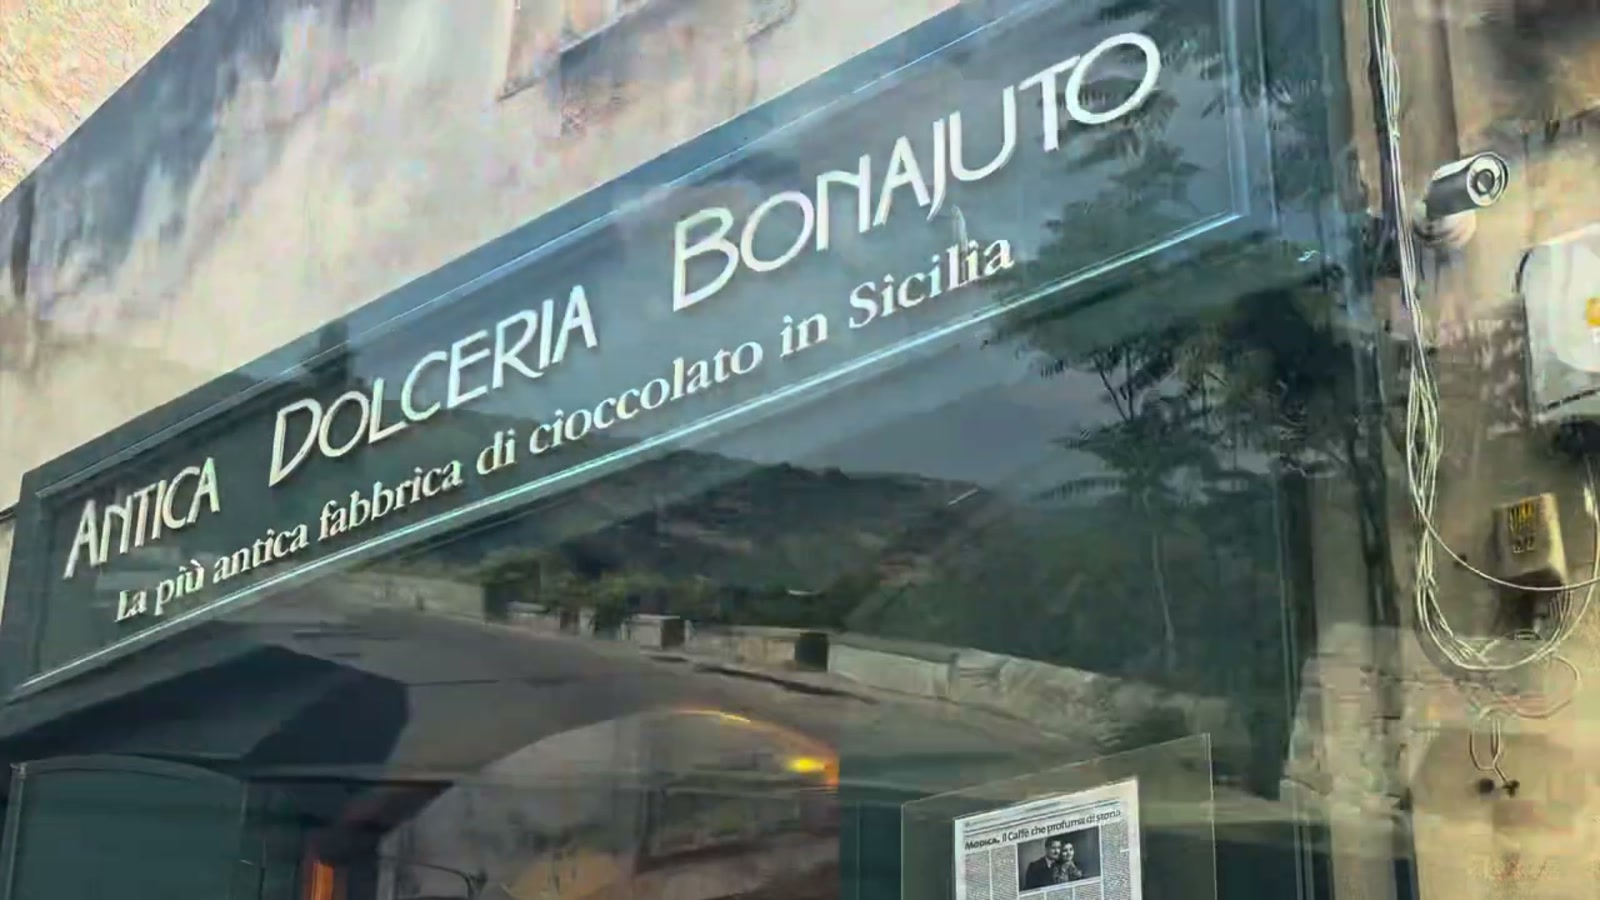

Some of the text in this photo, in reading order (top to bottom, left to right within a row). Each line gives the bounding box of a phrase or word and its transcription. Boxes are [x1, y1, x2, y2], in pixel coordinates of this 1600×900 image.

[63, 32, 1161, 580] ANTICA DOLCERIA BONAJUTO
[114, 238, 1016, 623] La più antica fabbrica di cioccolato in Sicilia
[1046, 816, 1086, 834] profuma
